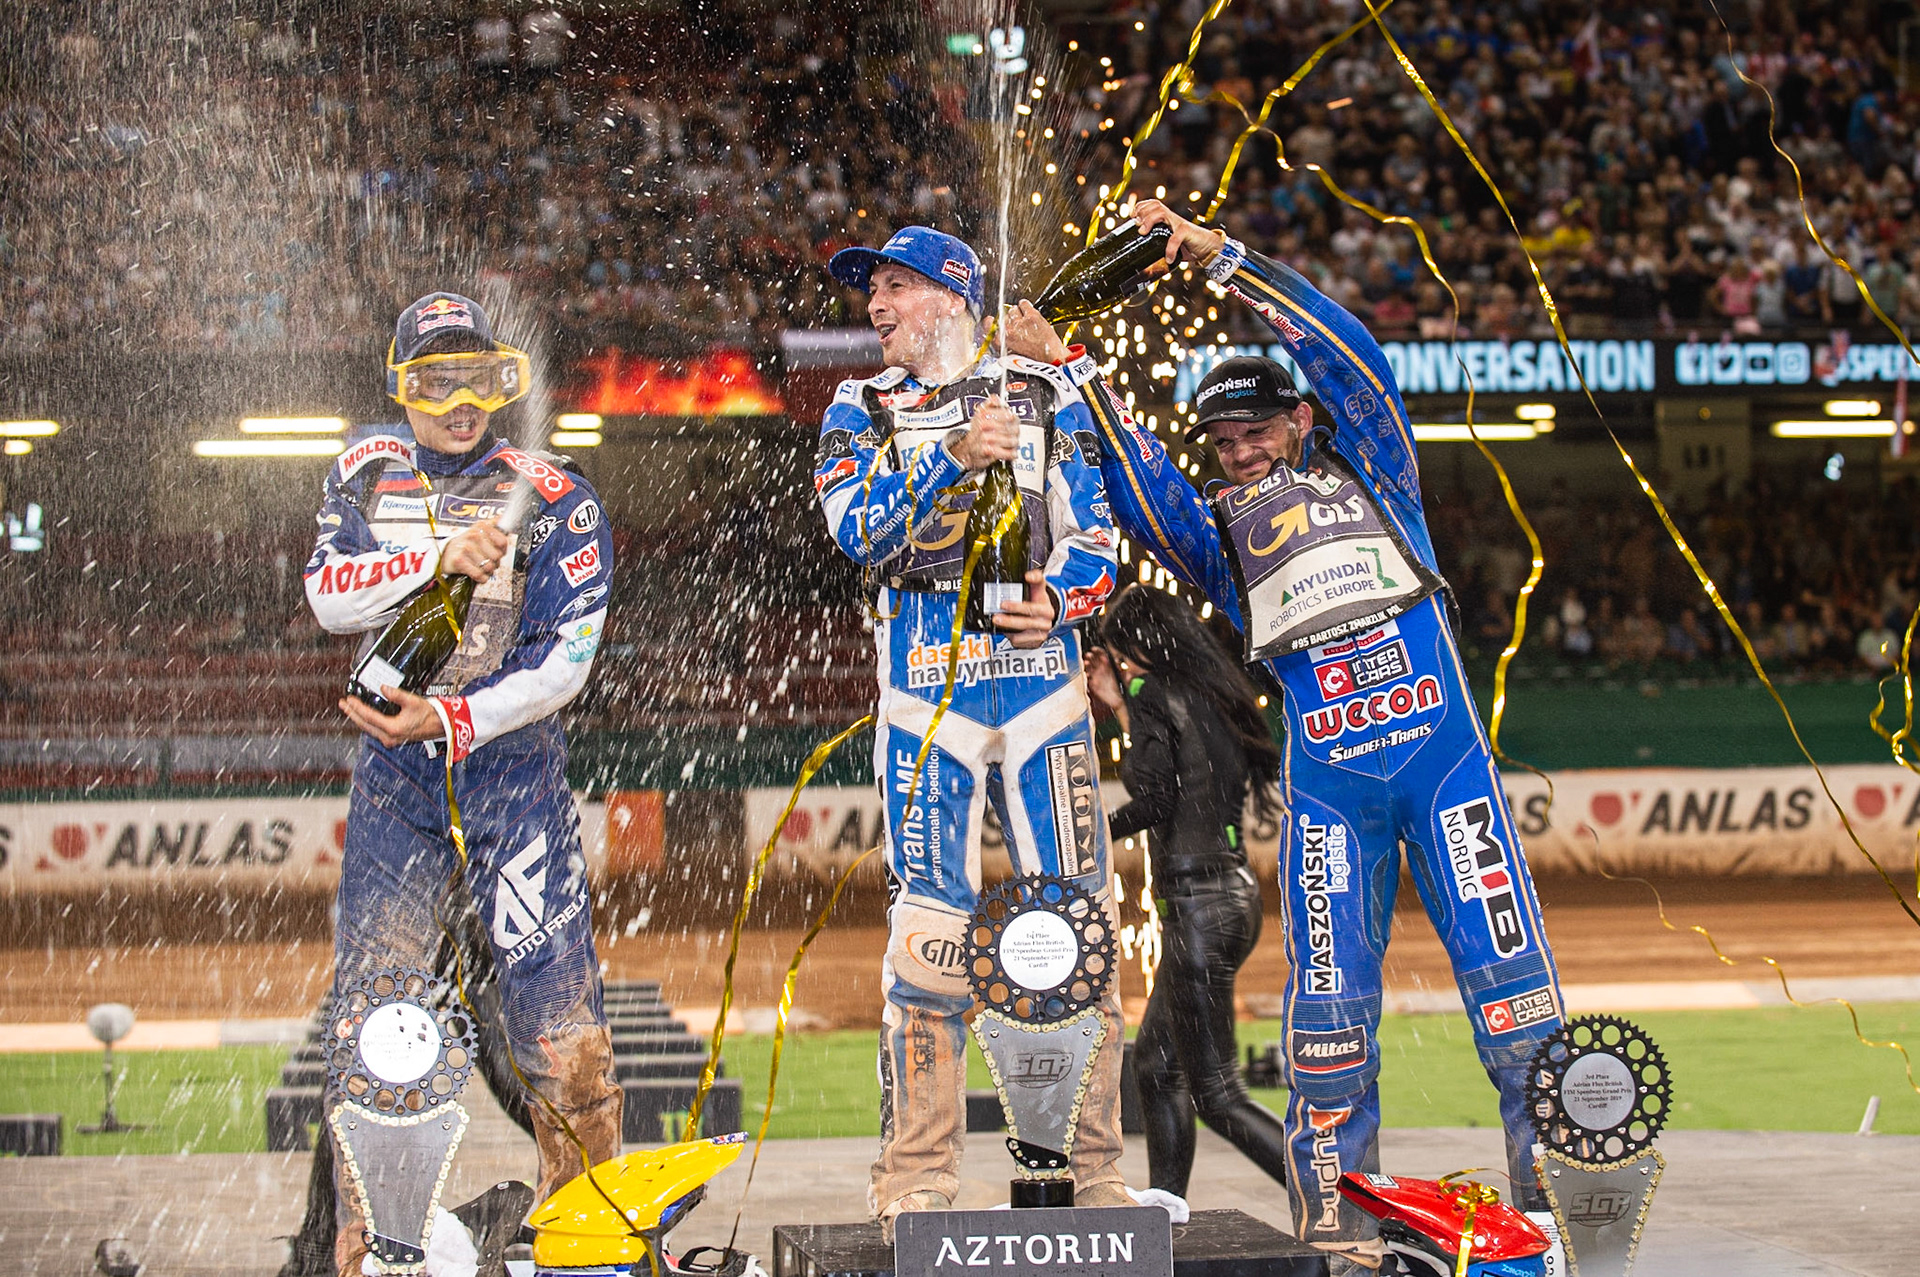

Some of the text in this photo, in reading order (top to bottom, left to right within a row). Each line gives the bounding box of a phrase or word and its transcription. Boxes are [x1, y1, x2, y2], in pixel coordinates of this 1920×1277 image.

[419, 317, 444, 333] Red
[1274, 314, 1305, 340] Häuser
[1387, 339, 1655, 393] ONVERSATION
[1226, 388, 1258, 399] logistic
[1257, 472, 1282, 494] GLS
[1309, 494, 1366, 527] GLS
[1292, 561, 1371, 598] HYUNDAI
[1269, 579, 1377, 633] ROBOTICS EUROPE
[1291, 634, 1310, 651] #95
[1310, 620, 1349, 647] BARTOSZ
[1347, 611, 1388, 635] ZMARZLIK
[1387, 604, 1404, 618] POL
[1352, 647, 1399, 675] INTER
[1356, 661, 1403, 687] CARS
[1057, 771, 1069, 809] niepalne
[896, 749, 930, 883] Trans MF
[926, 746, 947, 889] Internationale Spedition
[1641, 787, 1816, 835] ANLAS
[106, 819, 295, 869] ANLAS
[1061, 814, 1075, 874] trudnozapalne
[1328, 824, 1348, 891] logistic
[1444, 810, 1479, 898] NORDIC
[1301, 826, 1333, 993] MASZOŃSKI
[505, 931, 547, 969] AUTO
[1512, 992, 1551, 1013] INTER
[1515, 1002, 1554, 1023] CARS
[1298, 1039, 1360, 1059] Mitas
[1570, 1191, 1633, 1216] SGP
[935, 1233, 1135, 1268] AZTORIN
